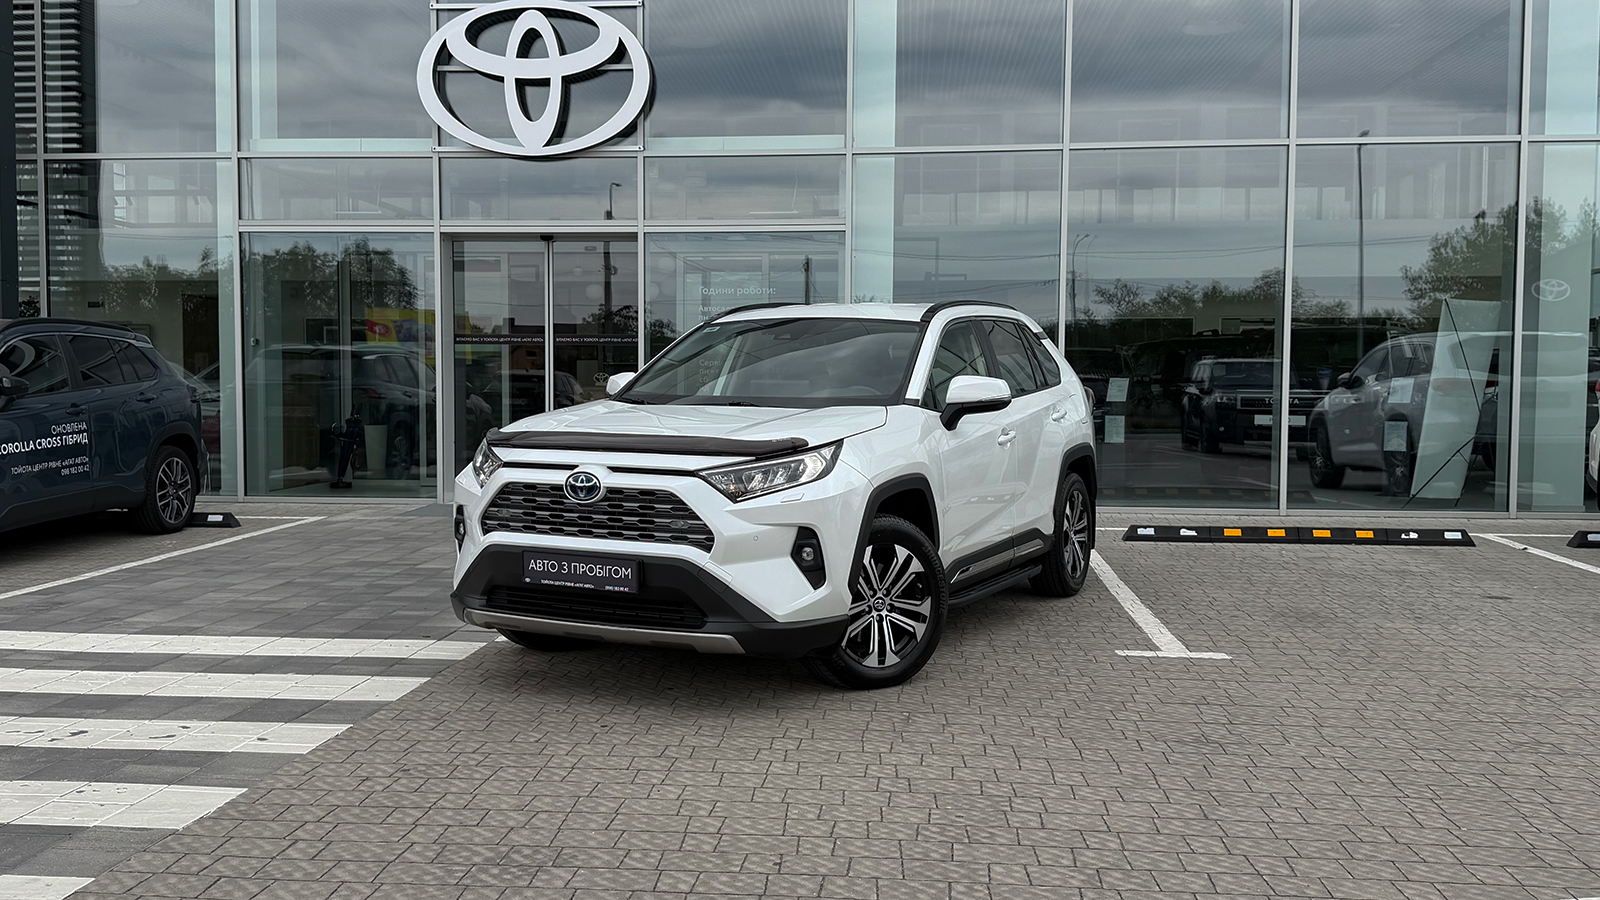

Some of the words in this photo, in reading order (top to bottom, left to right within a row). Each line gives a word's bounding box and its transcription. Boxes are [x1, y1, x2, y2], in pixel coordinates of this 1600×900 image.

[698, 286, 734, 296] Години
[736, 286, 776, 296] роботи:
[51, 422, 87, 434] ОНОВЛЕНА
[36, 436, 61, 449] CROSS
[62, 432, 88, 446] ГІБРИД
[11, 464, 32, 474] ТОЙОТА
[33, 462, 48, 472] ЦЕНТР
[49, 460, 62, 468] РІВНЕ
[62, 458, 75, 466] «АГАТ
[75, 456, 89, 464] АВТО»
[528, 559, 558, 573] АВТО
[571, 562, 632, 579] ПРОБІГОМ
